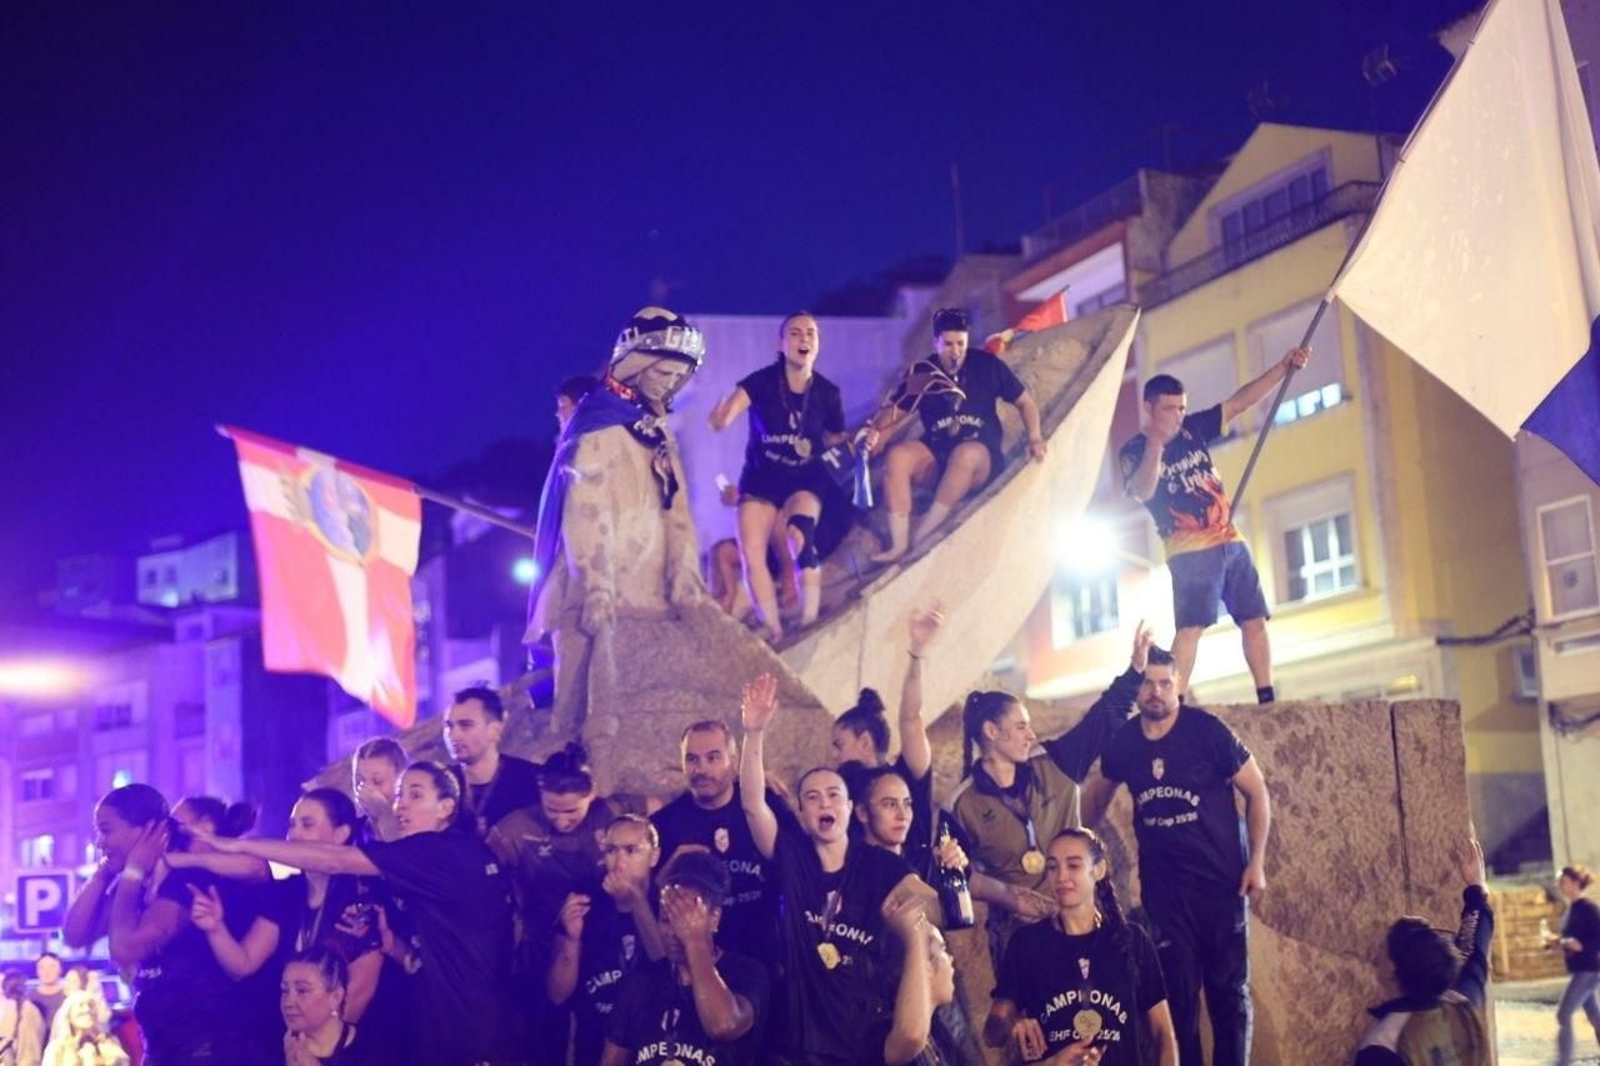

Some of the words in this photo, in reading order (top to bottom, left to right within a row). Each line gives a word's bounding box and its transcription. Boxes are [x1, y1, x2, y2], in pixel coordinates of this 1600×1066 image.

[25, 878, 61, 927] P
[1040, 990, 1127, 1025] CAMPONAS
[1049, 1030, 1071, 1042] EHF
